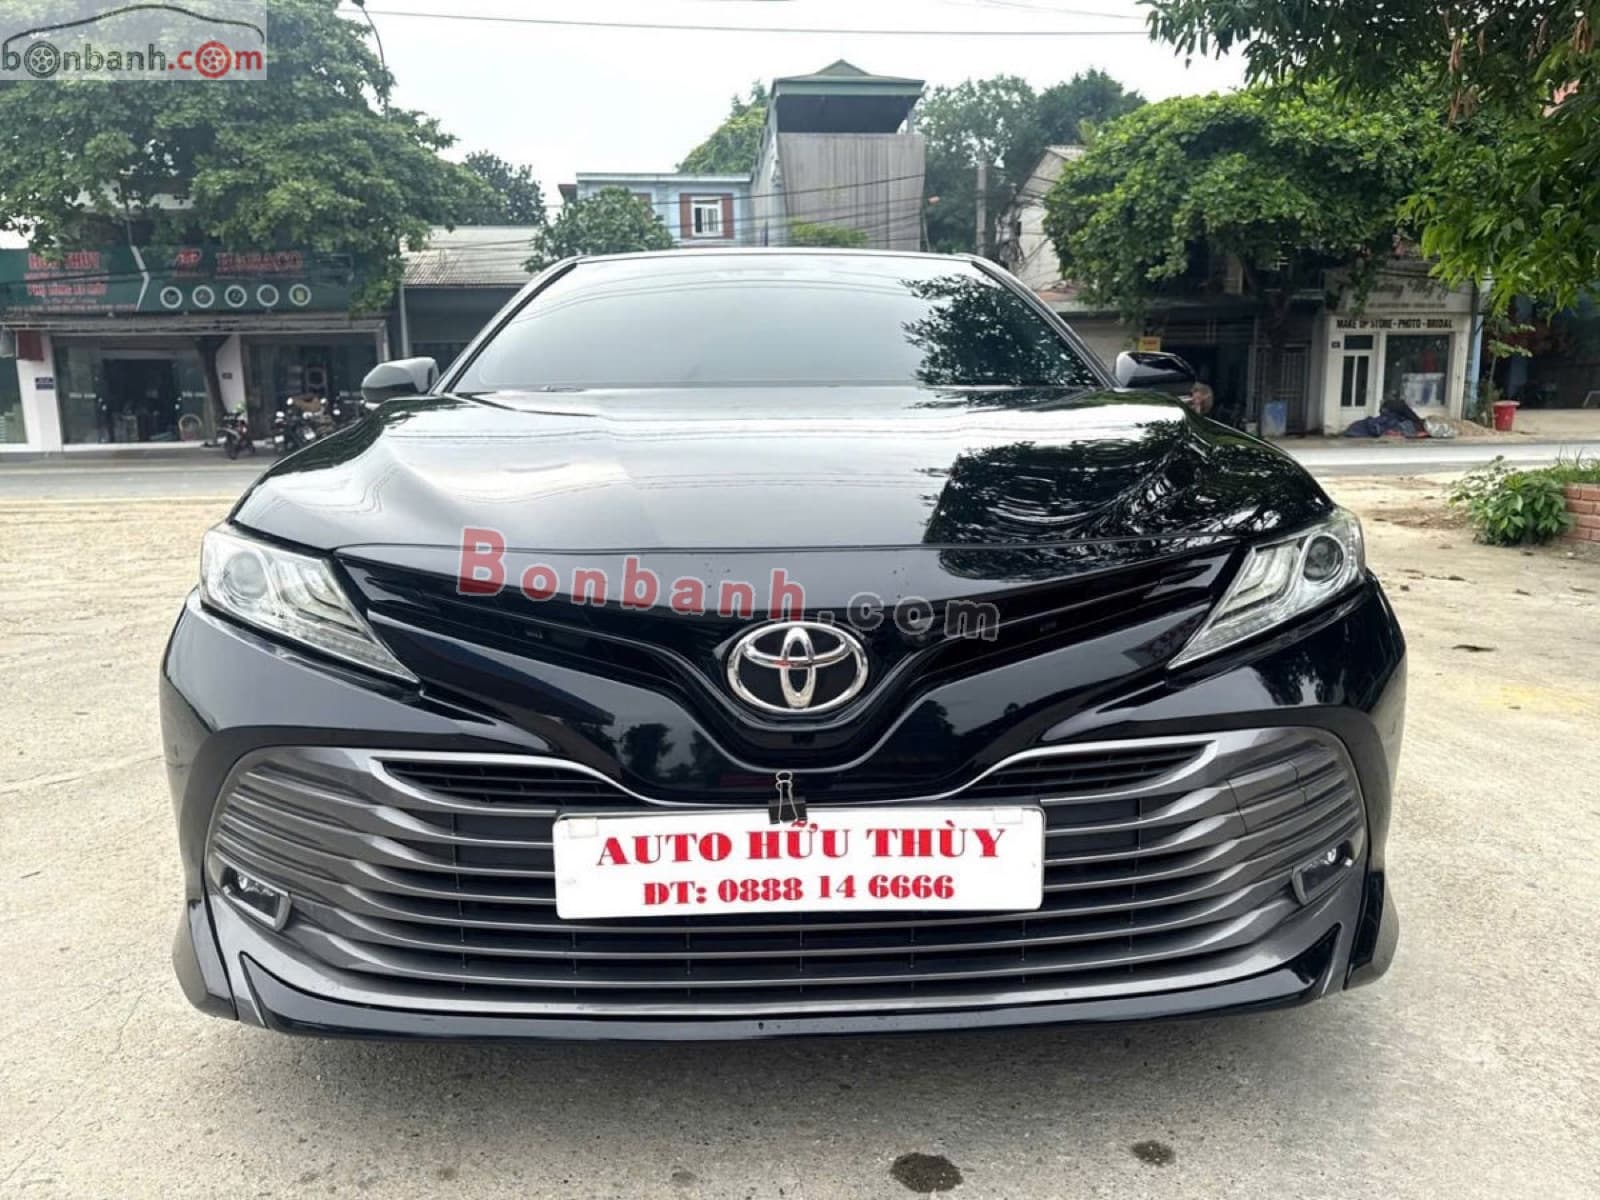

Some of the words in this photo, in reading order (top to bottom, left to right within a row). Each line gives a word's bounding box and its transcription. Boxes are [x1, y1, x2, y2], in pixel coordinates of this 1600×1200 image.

[1336, 318, 1357, 329] MAKE
[1398, 319, 1421, 329] PHOTO
[1426, 319, 1453, 329] BRIDAL
[595, 832, 733, 867] AUTO
[745, 818, 851, 861] HỮU
[866, 819, 1007, 859] THÙY
[717, 876, 804, 904] 0888
[817, 874, 856, 899] 14
[867, 874, 955, 900] 6666
